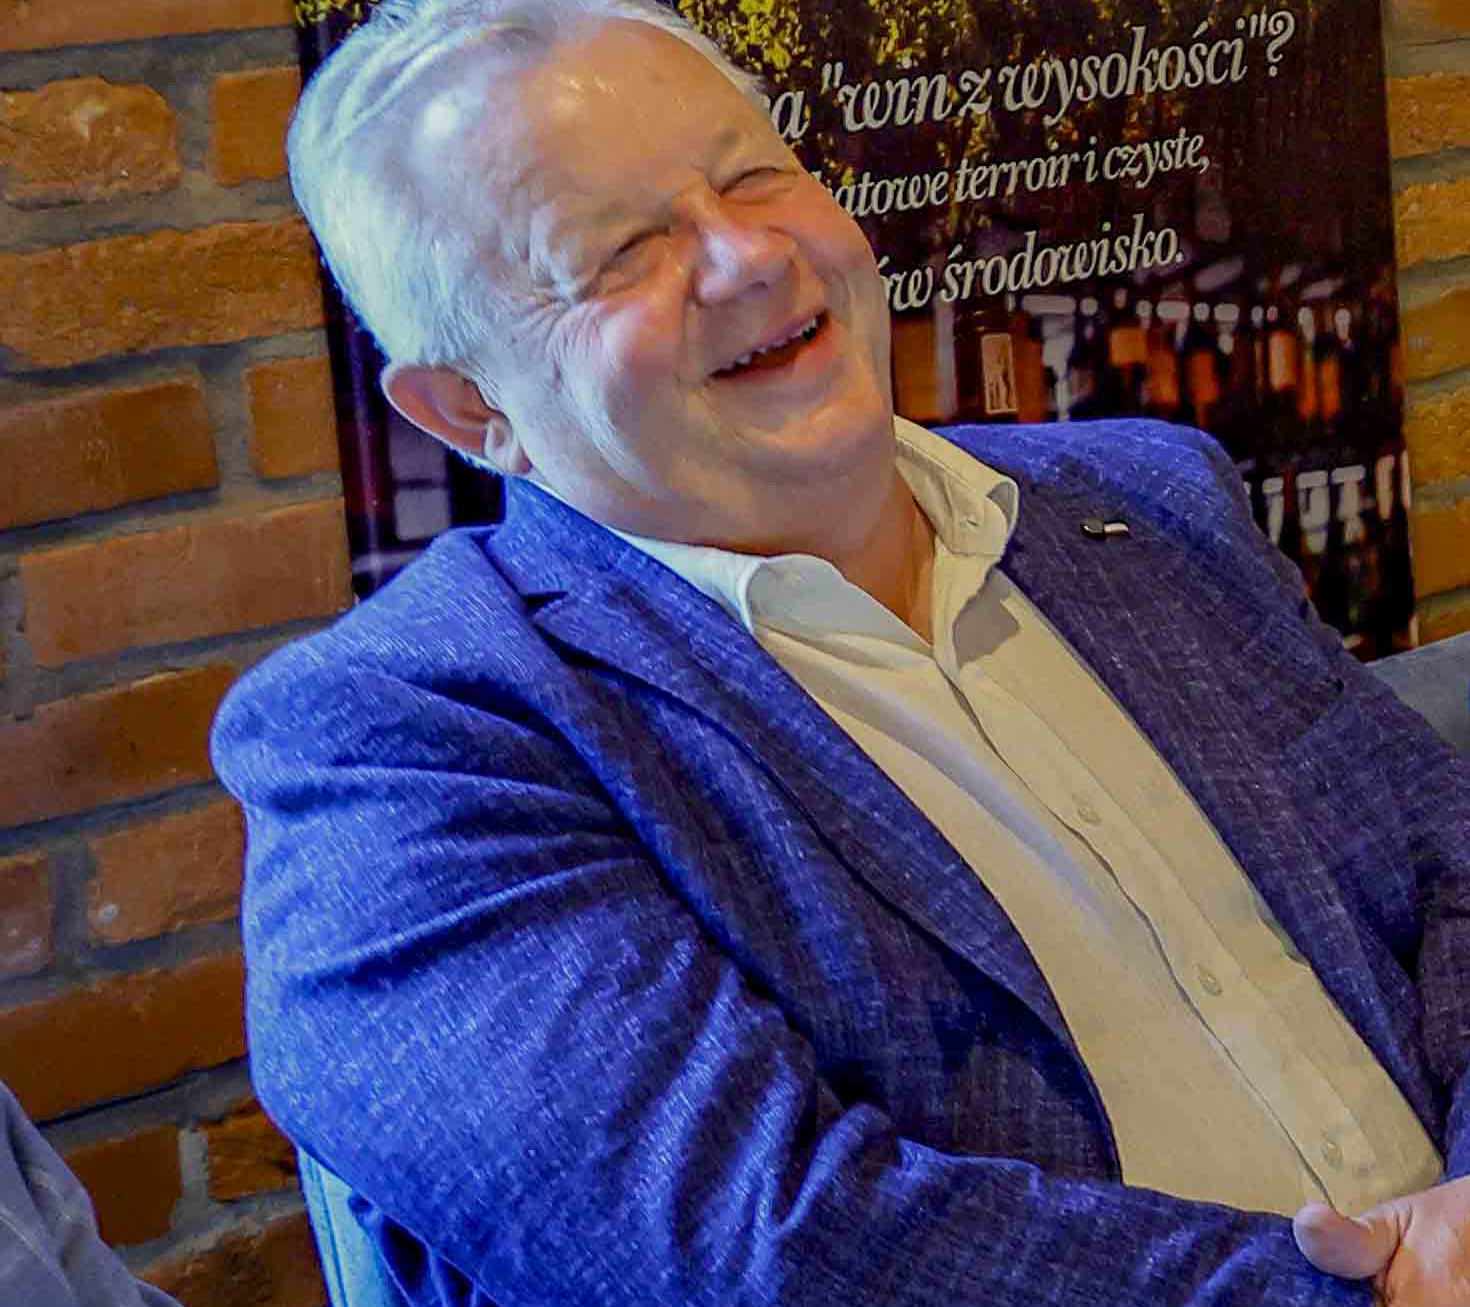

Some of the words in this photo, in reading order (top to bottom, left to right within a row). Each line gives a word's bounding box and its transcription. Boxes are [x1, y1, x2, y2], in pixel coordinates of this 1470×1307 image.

[958, 70, 994, 119] z
[812, 170, 949, 219] atowe
[954, 141, 1075, 205] terroir
[1083, 137, 1101, 182] i
[1102, 127, 1212, 190] czyste,
[939, 213, 1185, 304] środowisko.
